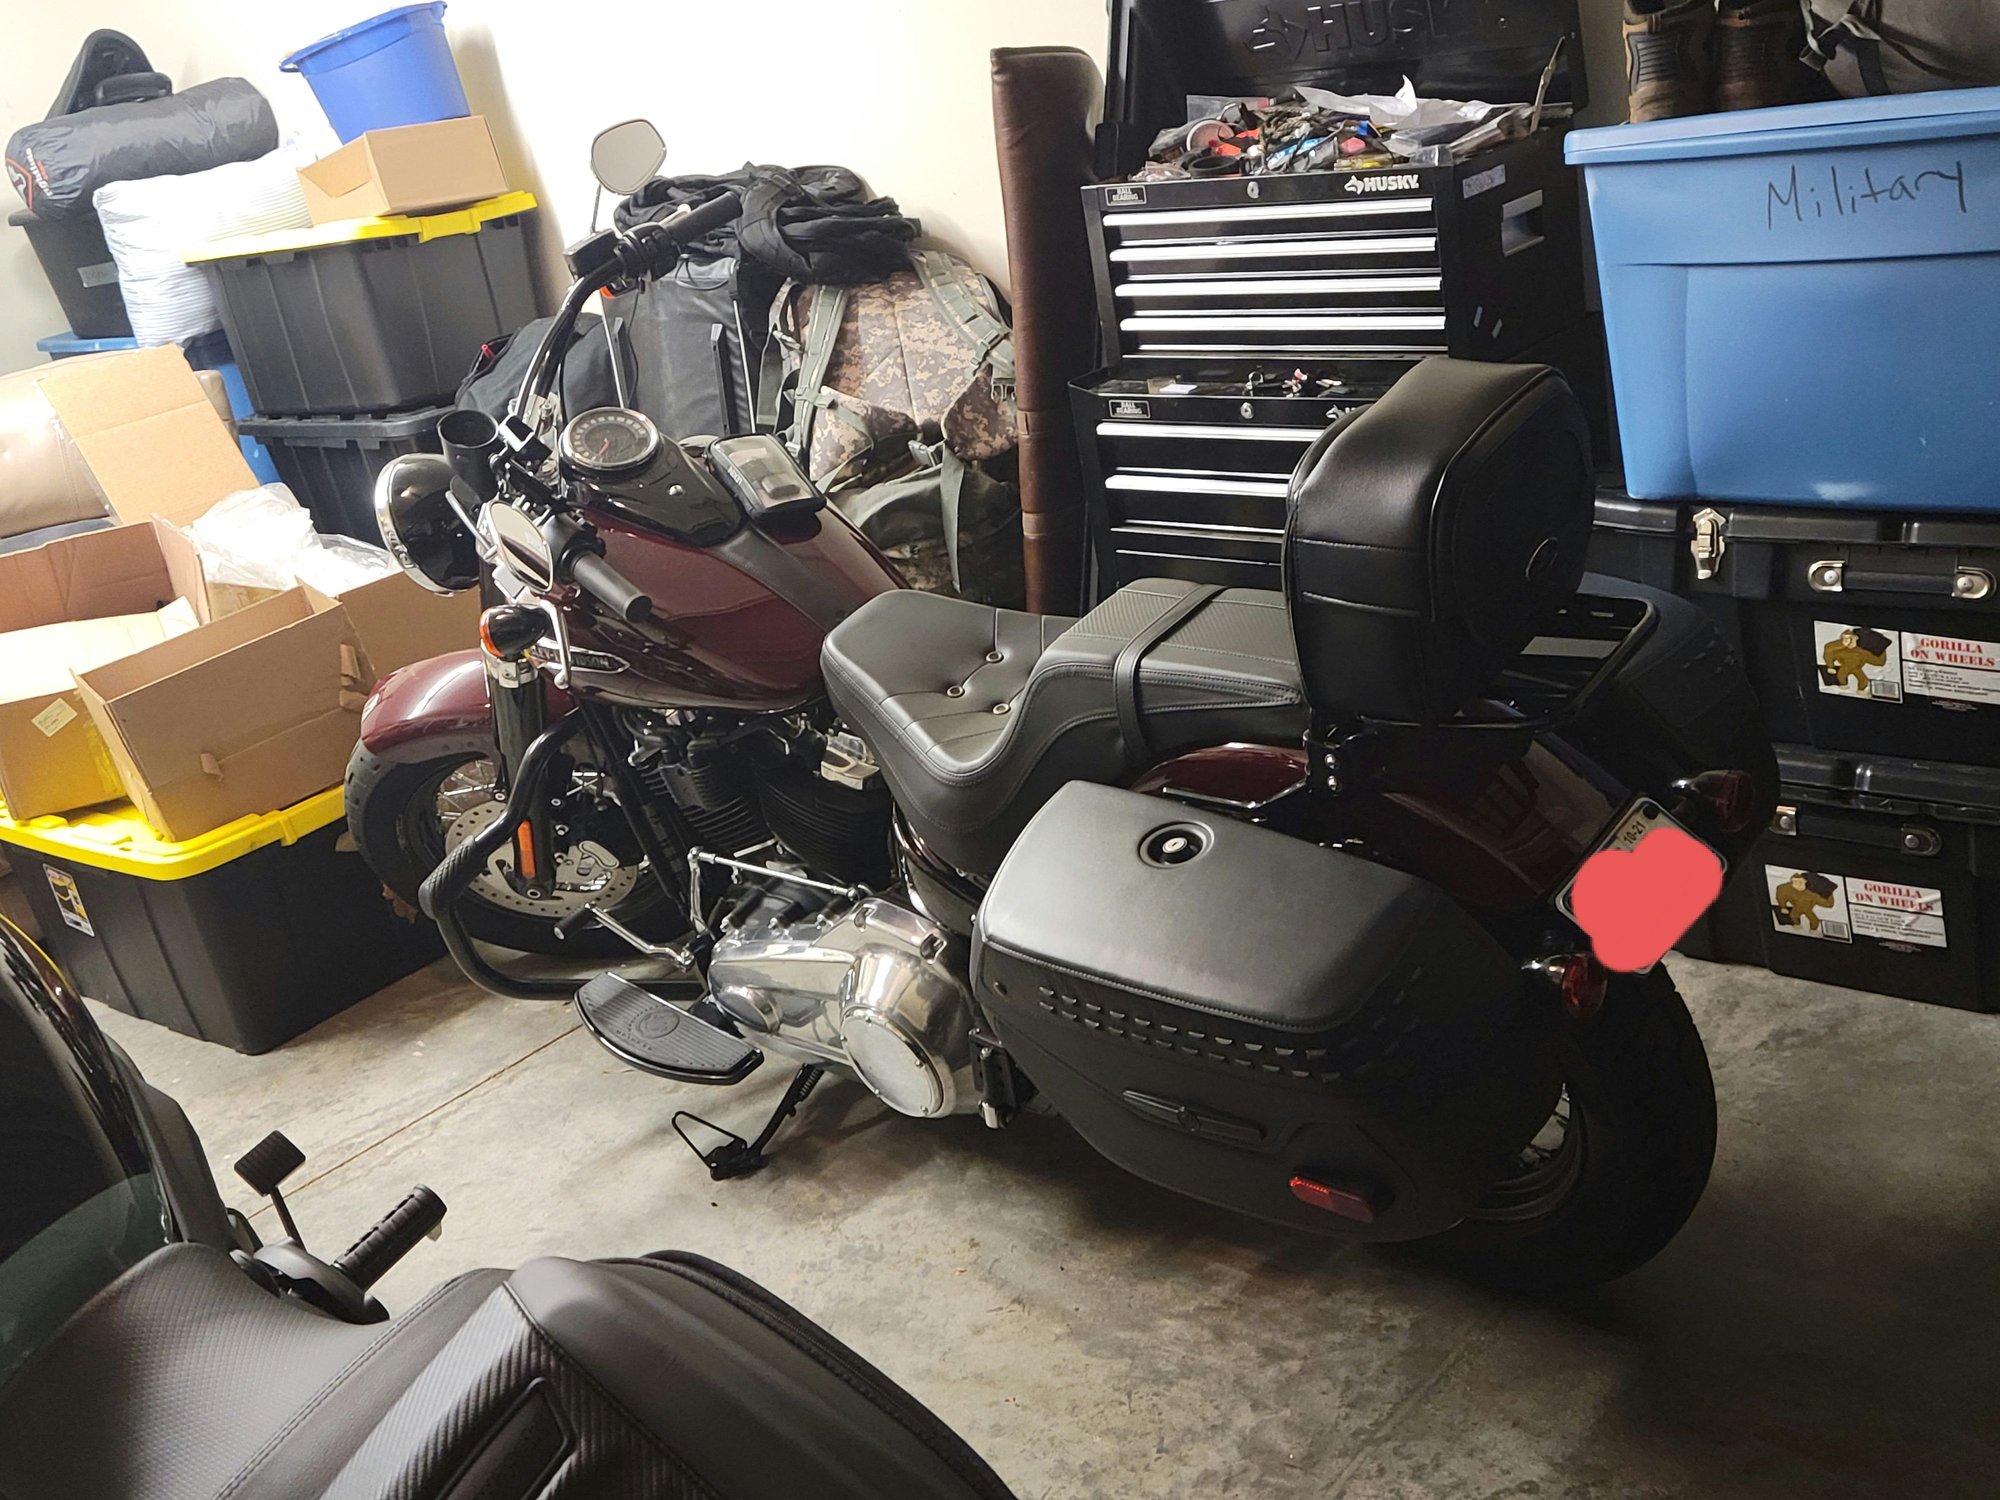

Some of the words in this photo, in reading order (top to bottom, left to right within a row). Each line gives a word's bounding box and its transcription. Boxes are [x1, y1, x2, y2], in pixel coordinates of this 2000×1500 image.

[1363, 174, 1420, 192] HUSKY
[1768, 160, 1967, 230] Military
[1920, 638, 1983, 654] GORILLA
[1910, 649, 1929, 659] ON
[1935, 652, 1995, 667] WHEELS
[1623, 820, 1646, 844] 10-21
[1864, 883, 1922, 899] GORILLA
[1855, 893, 1873, 903] ON
[1878, 895, 1934, 911] WHEELS
